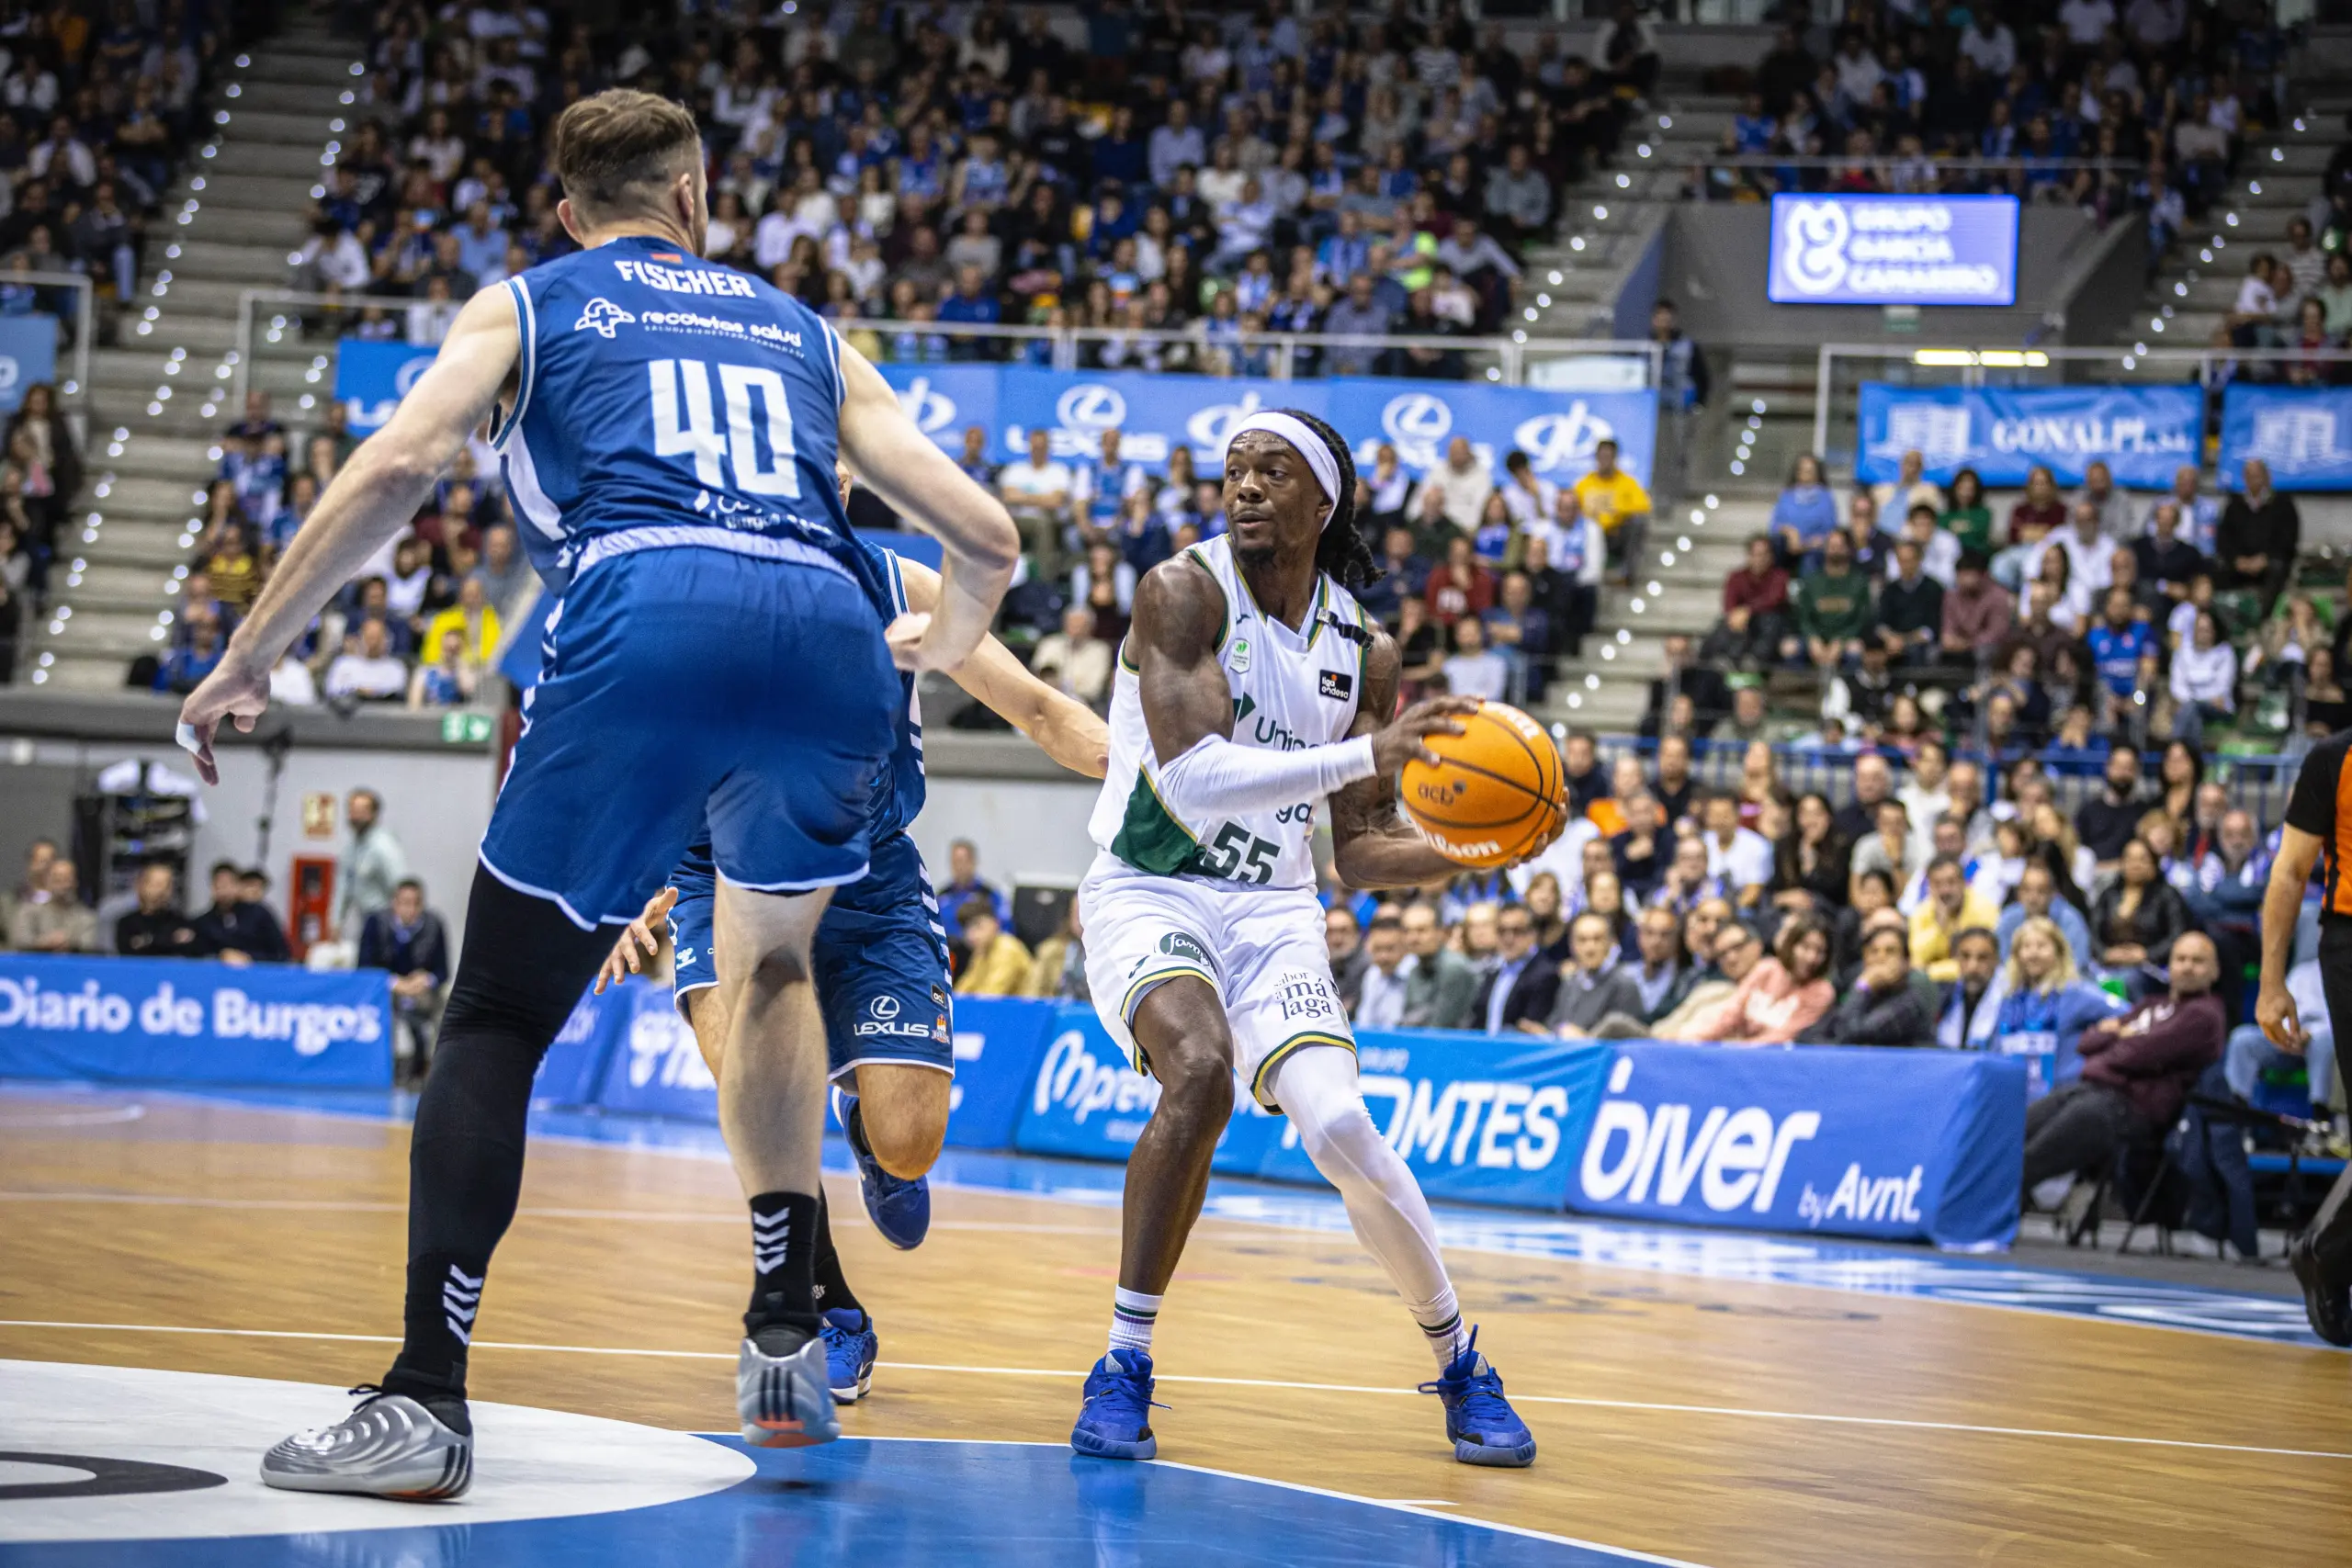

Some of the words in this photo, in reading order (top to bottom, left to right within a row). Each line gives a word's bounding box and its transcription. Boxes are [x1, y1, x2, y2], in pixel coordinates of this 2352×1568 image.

[614, 260, 757, 298] FISCHER
[641, 310, 744, 333] recoletas
[750, 322, 802, 347] salud
[649, 359, 801, 499] 40
[1321, 676, 1336, 688] liga
[1321, 685, 1349, 699] endesa
[1204, 820, 1281, 885] 55
[0, 976, 132, 1033] Diario
[140, 981, 203, 1036] de
[213, 987, 382, 1056] Burgos
[1281, 998, 1334, 1021] laga
[854, 1021, 930, 1037] LEXUS
[1797, 1183, 1830, 1229] by
